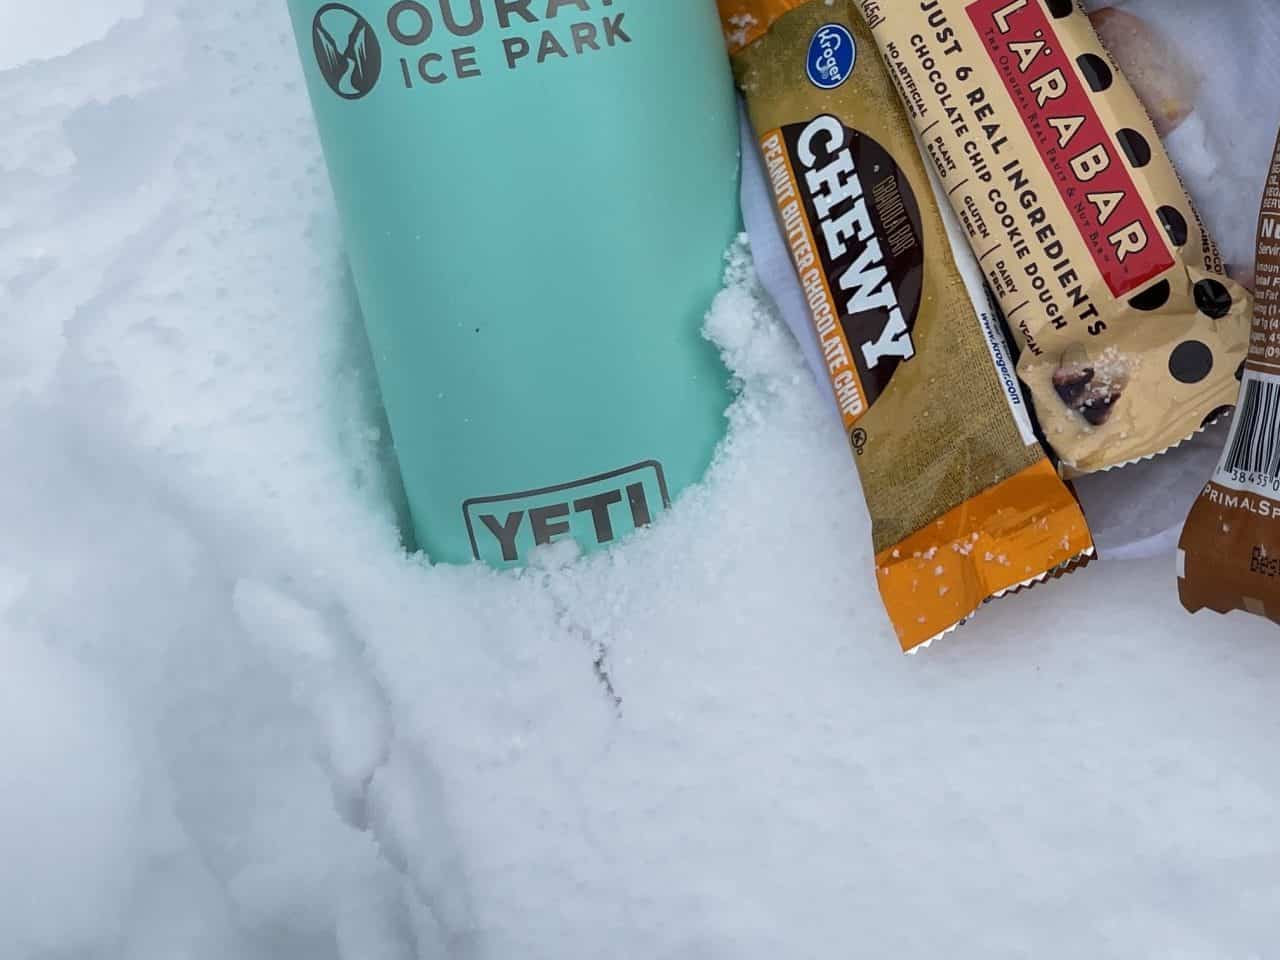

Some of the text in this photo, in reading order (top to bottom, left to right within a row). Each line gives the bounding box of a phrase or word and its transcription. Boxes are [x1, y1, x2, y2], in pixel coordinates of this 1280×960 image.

[400, 12, 632, 89] ICE PARK
[815, 28, 841, 81] Kroger
[886, 42, 929, 117] NO ARTIFICIAL
[910, 34, 969, 137] CHOCOLATE
[964, 141, 993, 182] CHIP
[987, 189, 1030, 260] COOKIE
[1023, 262, 1068, 331] DOUGH
[920, 0, 1108, 336] JUST 6 REAL INGREDIENTS
[934, 136, 957, 171] PLANT
[797, 114, 915, 369] CHEWY
[964, 196, 990, 239] GLUTEN
[761, 133, 795, 200] PEANUT
[781, 200, 810, 271] BUTTER
[801, 266, 849, 374] CHOCOLATE
[833, 368, 864, 419] CHIP
[996, 260, 1018, 294] DAIRY
[478, 481, 652, 561] YETI
